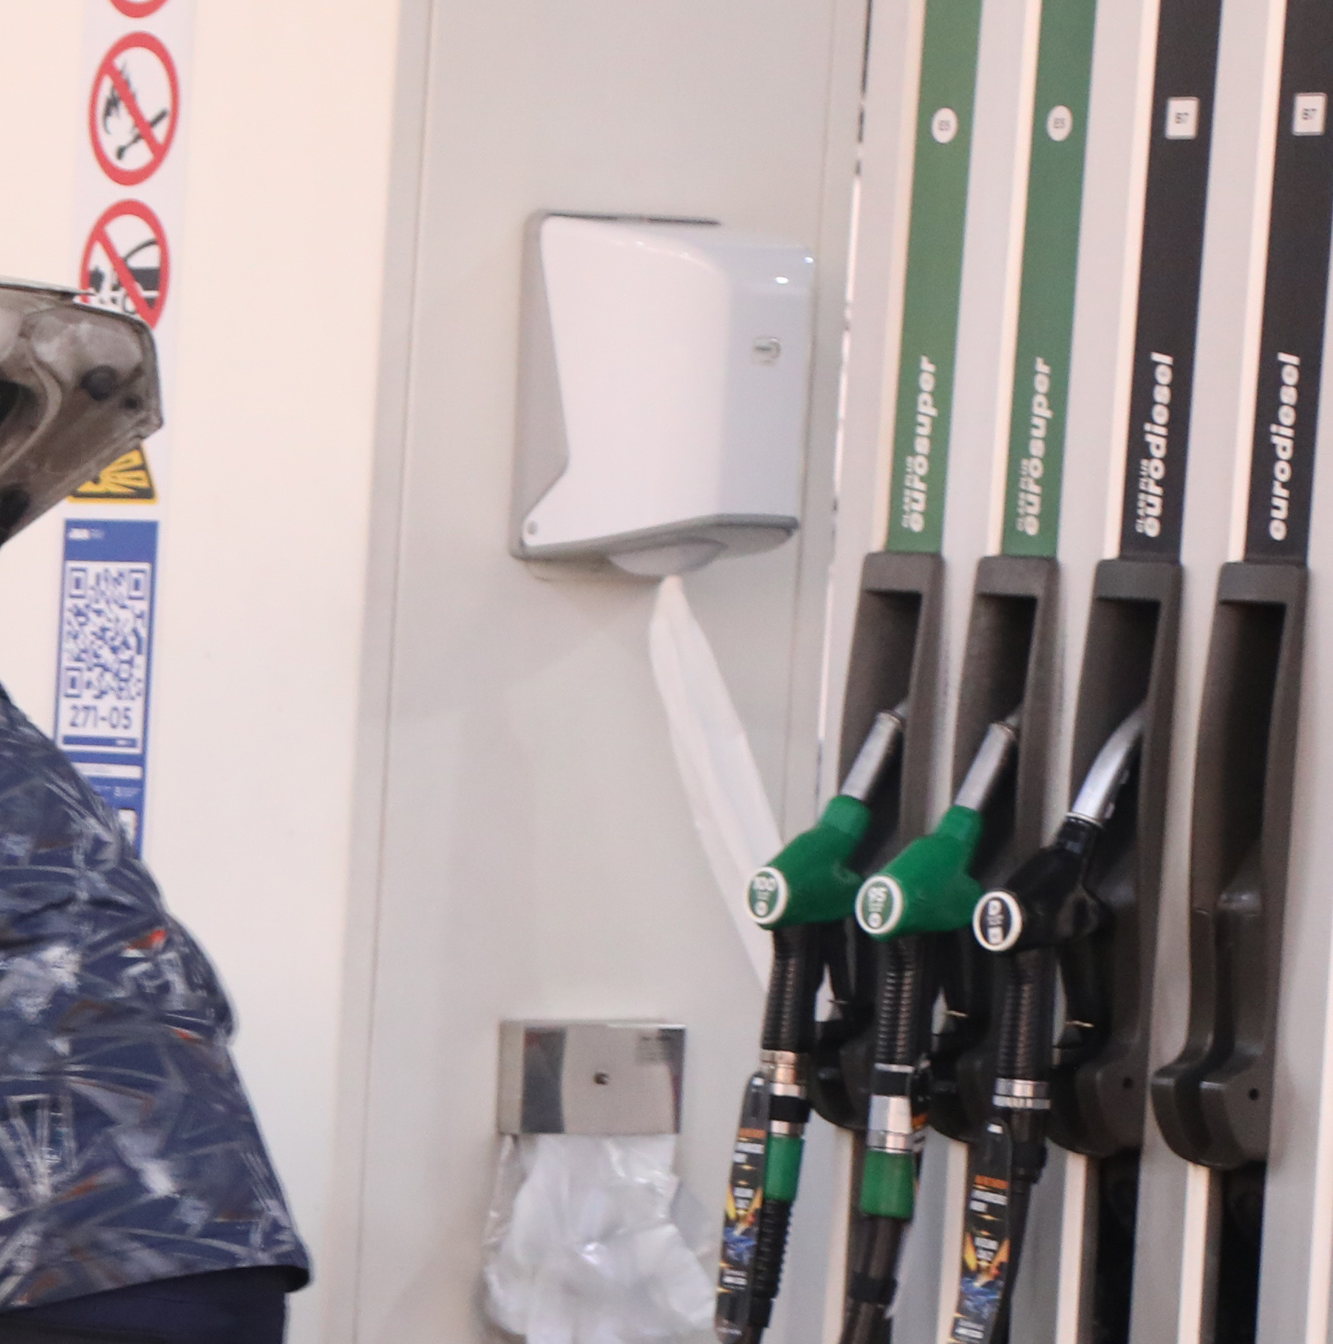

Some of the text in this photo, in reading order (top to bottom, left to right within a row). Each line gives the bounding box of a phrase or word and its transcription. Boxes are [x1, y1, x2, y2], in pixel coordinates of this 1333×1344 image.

[909, 354, 939, 533] eurosuper
[1024, 356, 1054, 536] eurosuper
[1143, 351, 1174, 538] eurodiesel
[1268, 351, 1301, 541] eurodiesel
[69, 704, 132, 730] 271-05
